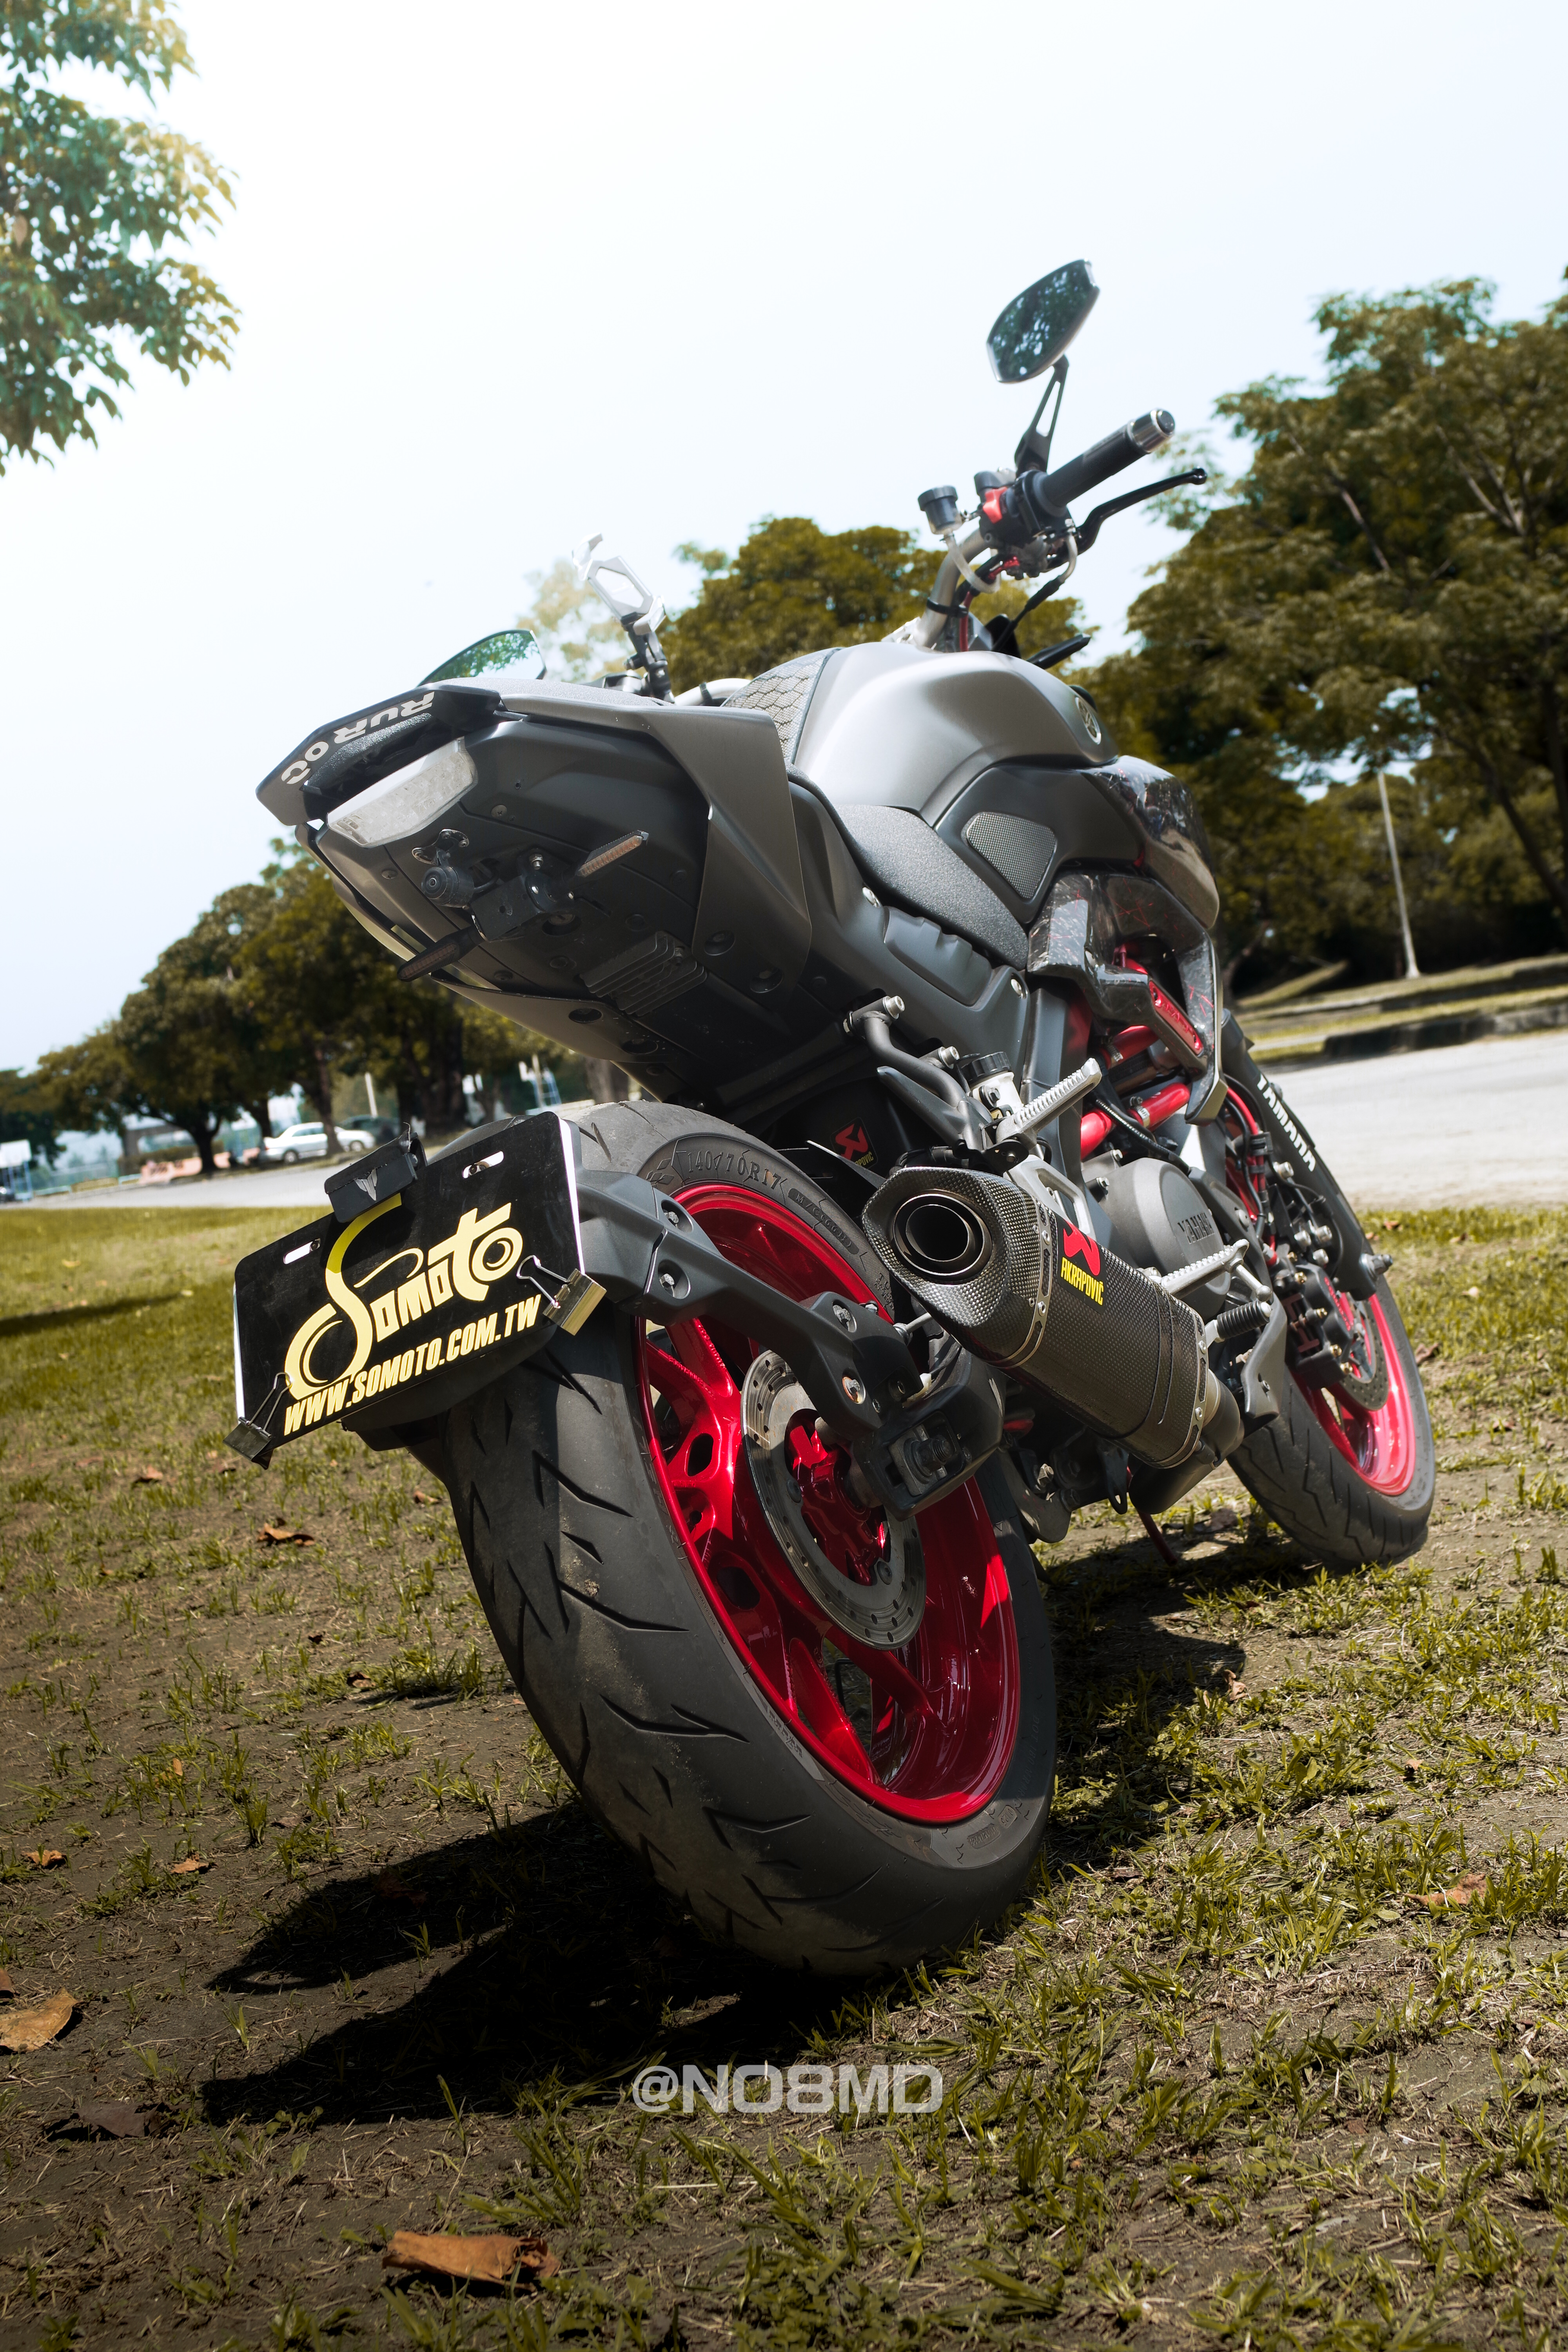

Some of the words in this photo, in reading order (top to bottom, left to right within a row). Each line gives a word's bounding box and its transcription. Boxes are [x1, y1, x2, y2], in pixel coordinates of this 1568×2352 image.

[281, 691, 434, 784] RUROC
[1178, 1212, 1215, 1245] YAMAHA
[284, 1294, 541, 1436] WWW.SOMOTO.COM.TW
